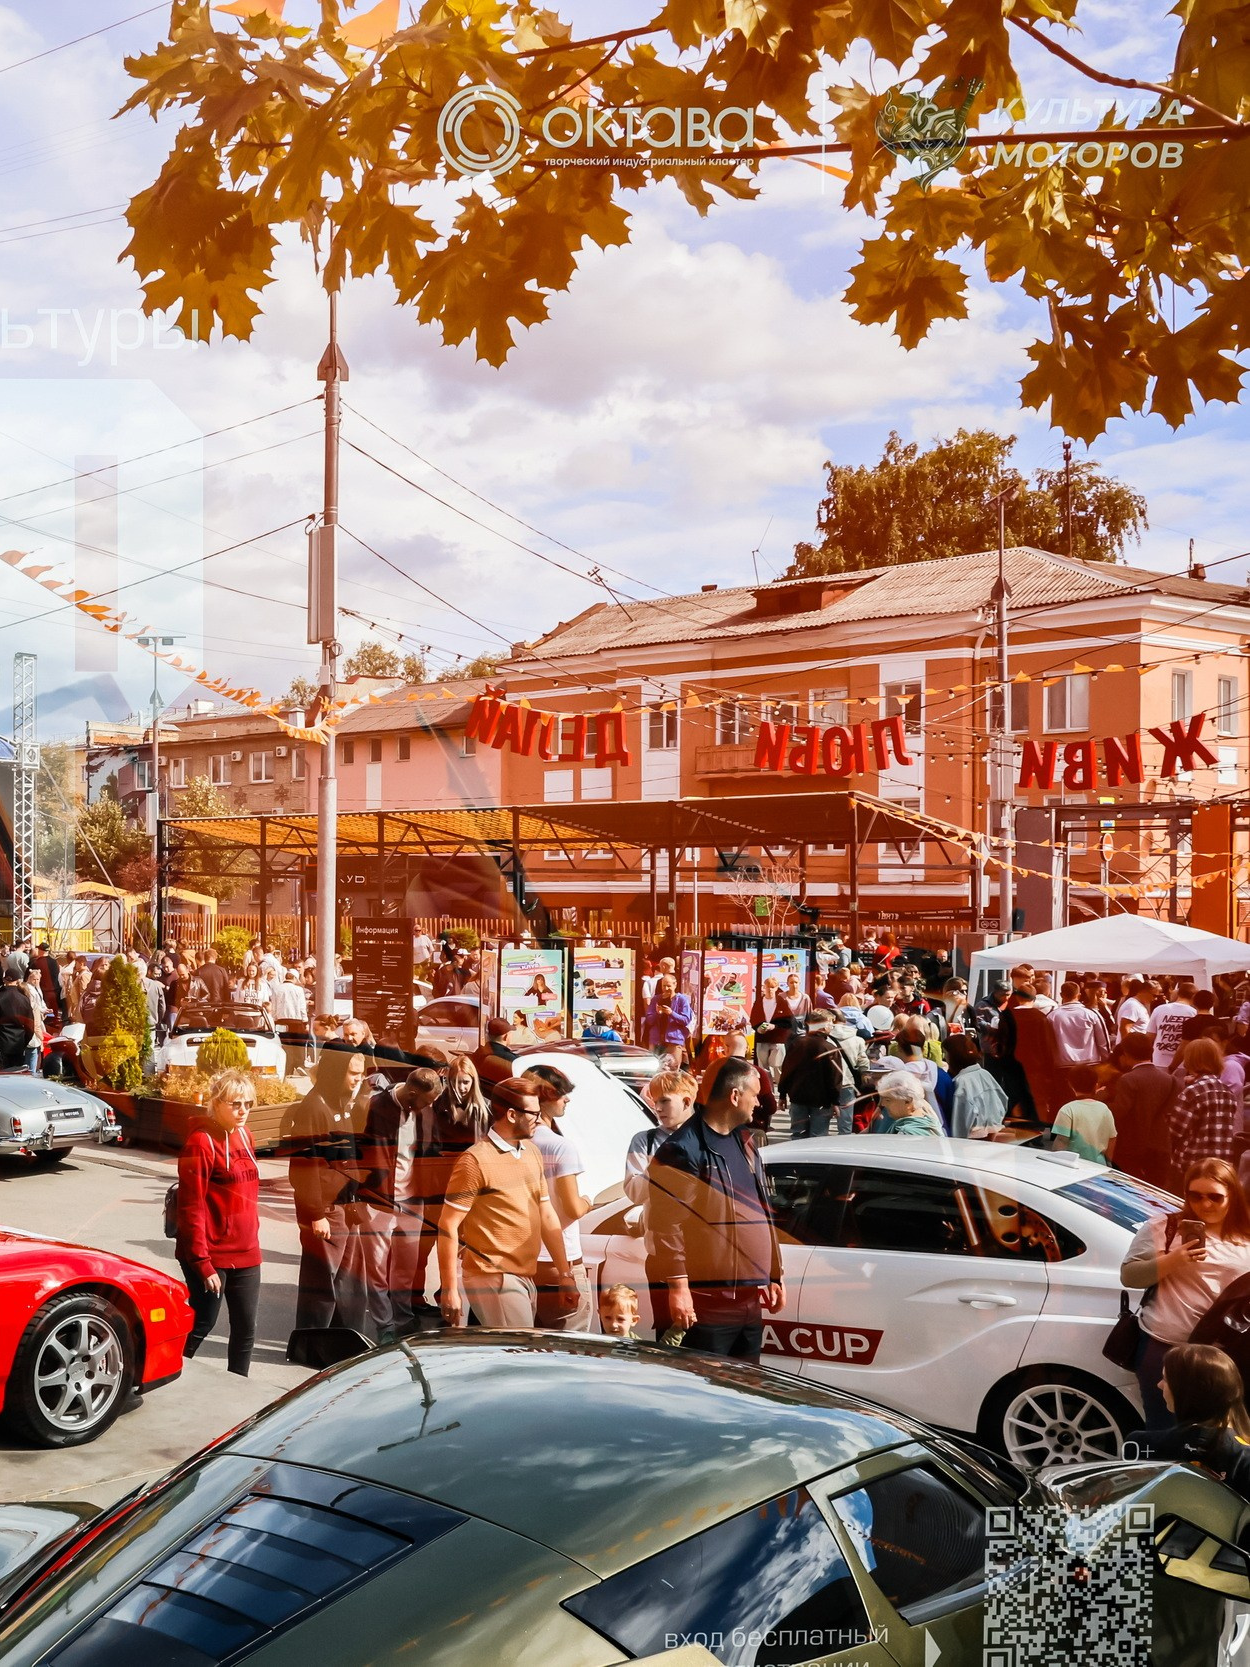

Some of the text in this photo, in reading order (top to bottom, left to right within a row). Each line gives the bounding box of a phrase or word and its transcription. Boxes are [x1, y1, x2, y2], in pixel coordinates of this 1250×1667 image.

[355, 926, 399, 936] Информация
[1158, 1024, 1183, 1036] MONE
[789, 1327, 870, 1358] CUP
